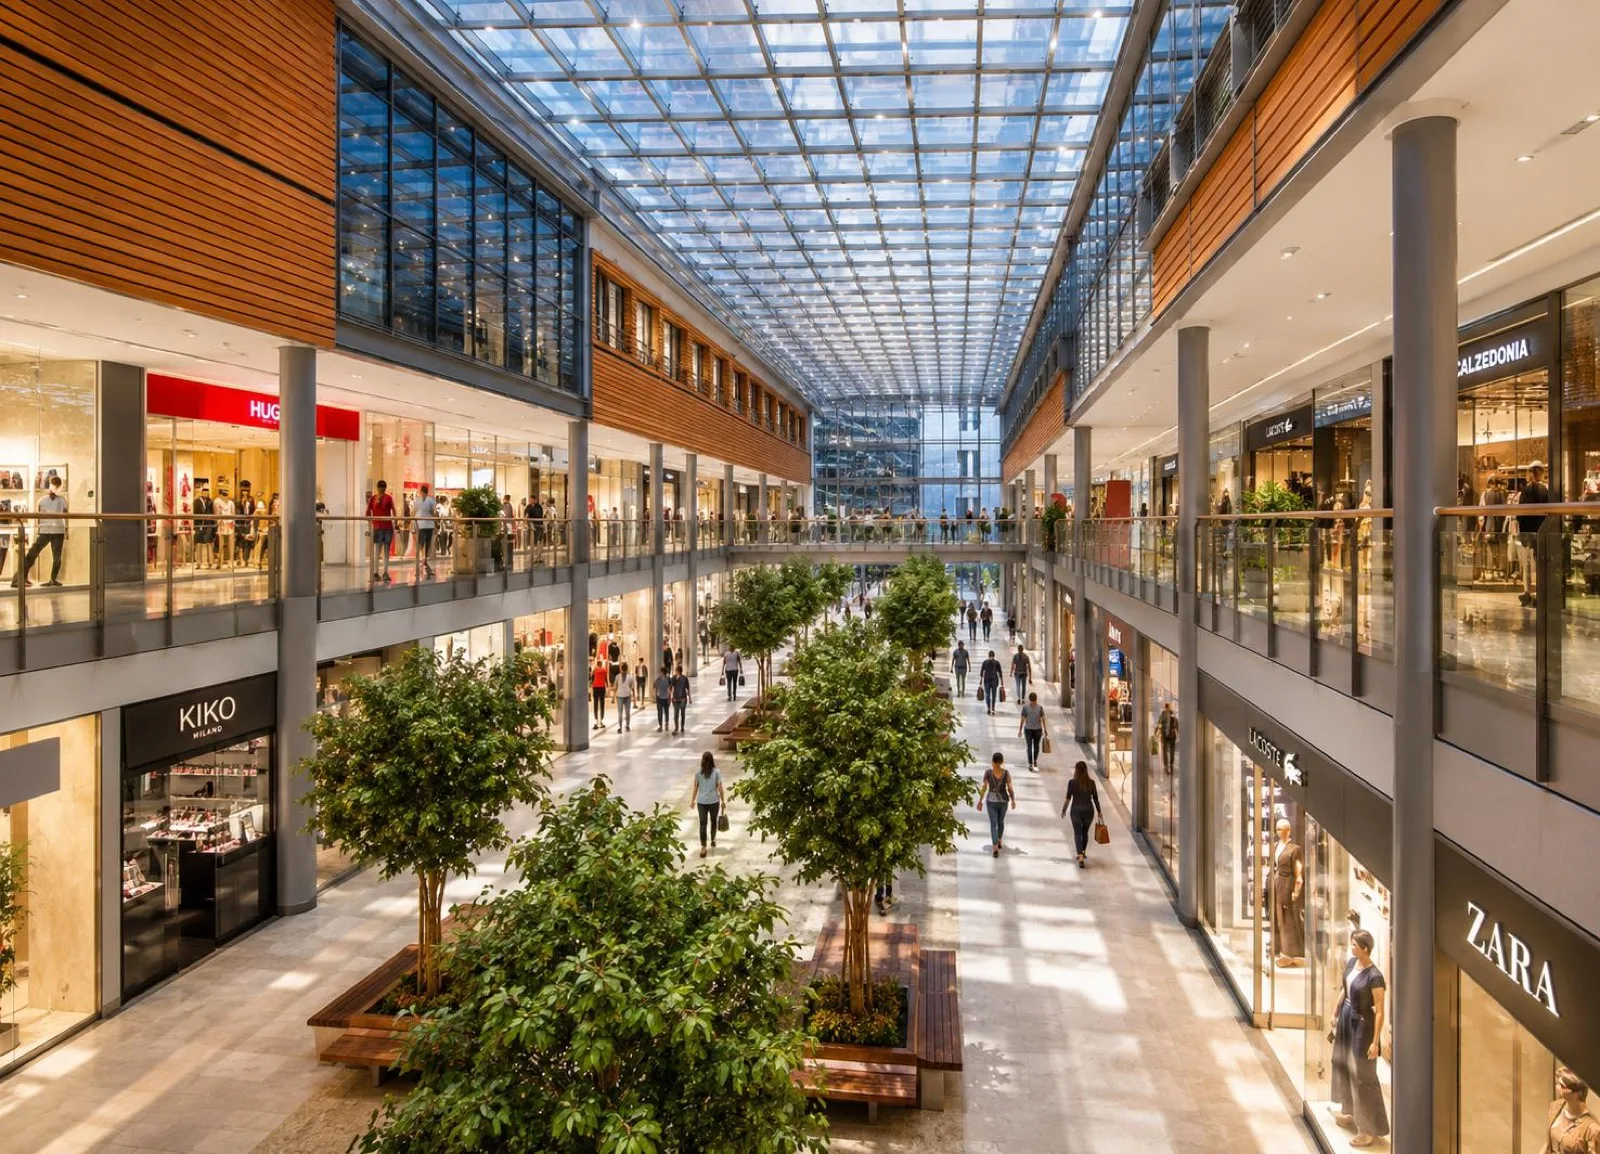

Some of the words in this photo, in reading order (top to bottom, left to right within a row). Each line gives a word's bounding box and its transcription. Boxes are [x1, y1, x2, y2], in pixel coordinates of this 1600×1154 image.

[250, 400, 280, 420] HUG
[180, 696, 236, 732] KIKO
[193, 725, 223, 739] MILANO
[1466, 901, 1560, 1017] ZARA
